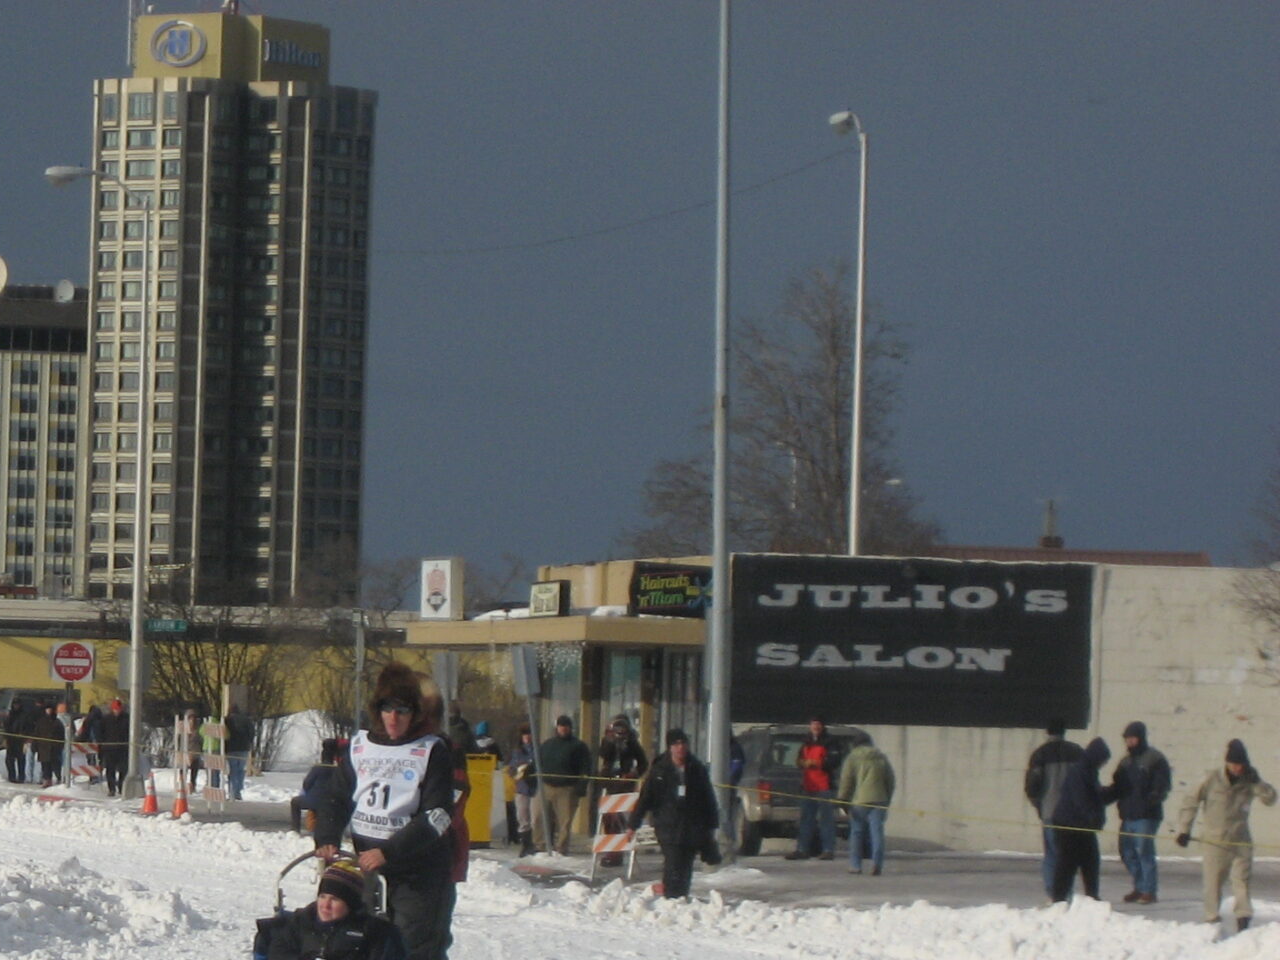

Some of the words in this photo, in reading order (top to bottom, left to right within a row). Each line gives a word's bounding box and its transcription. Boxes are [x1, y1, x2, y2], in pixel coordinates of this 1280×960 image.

[757, 579, 1068, 613] JULIO'S
[59, 649, 69, 657] DO
[72, 649, 87, 657] NOT
[756, 642, 1012, 672] SALON
[61, 666, 84, 674] ENTER
